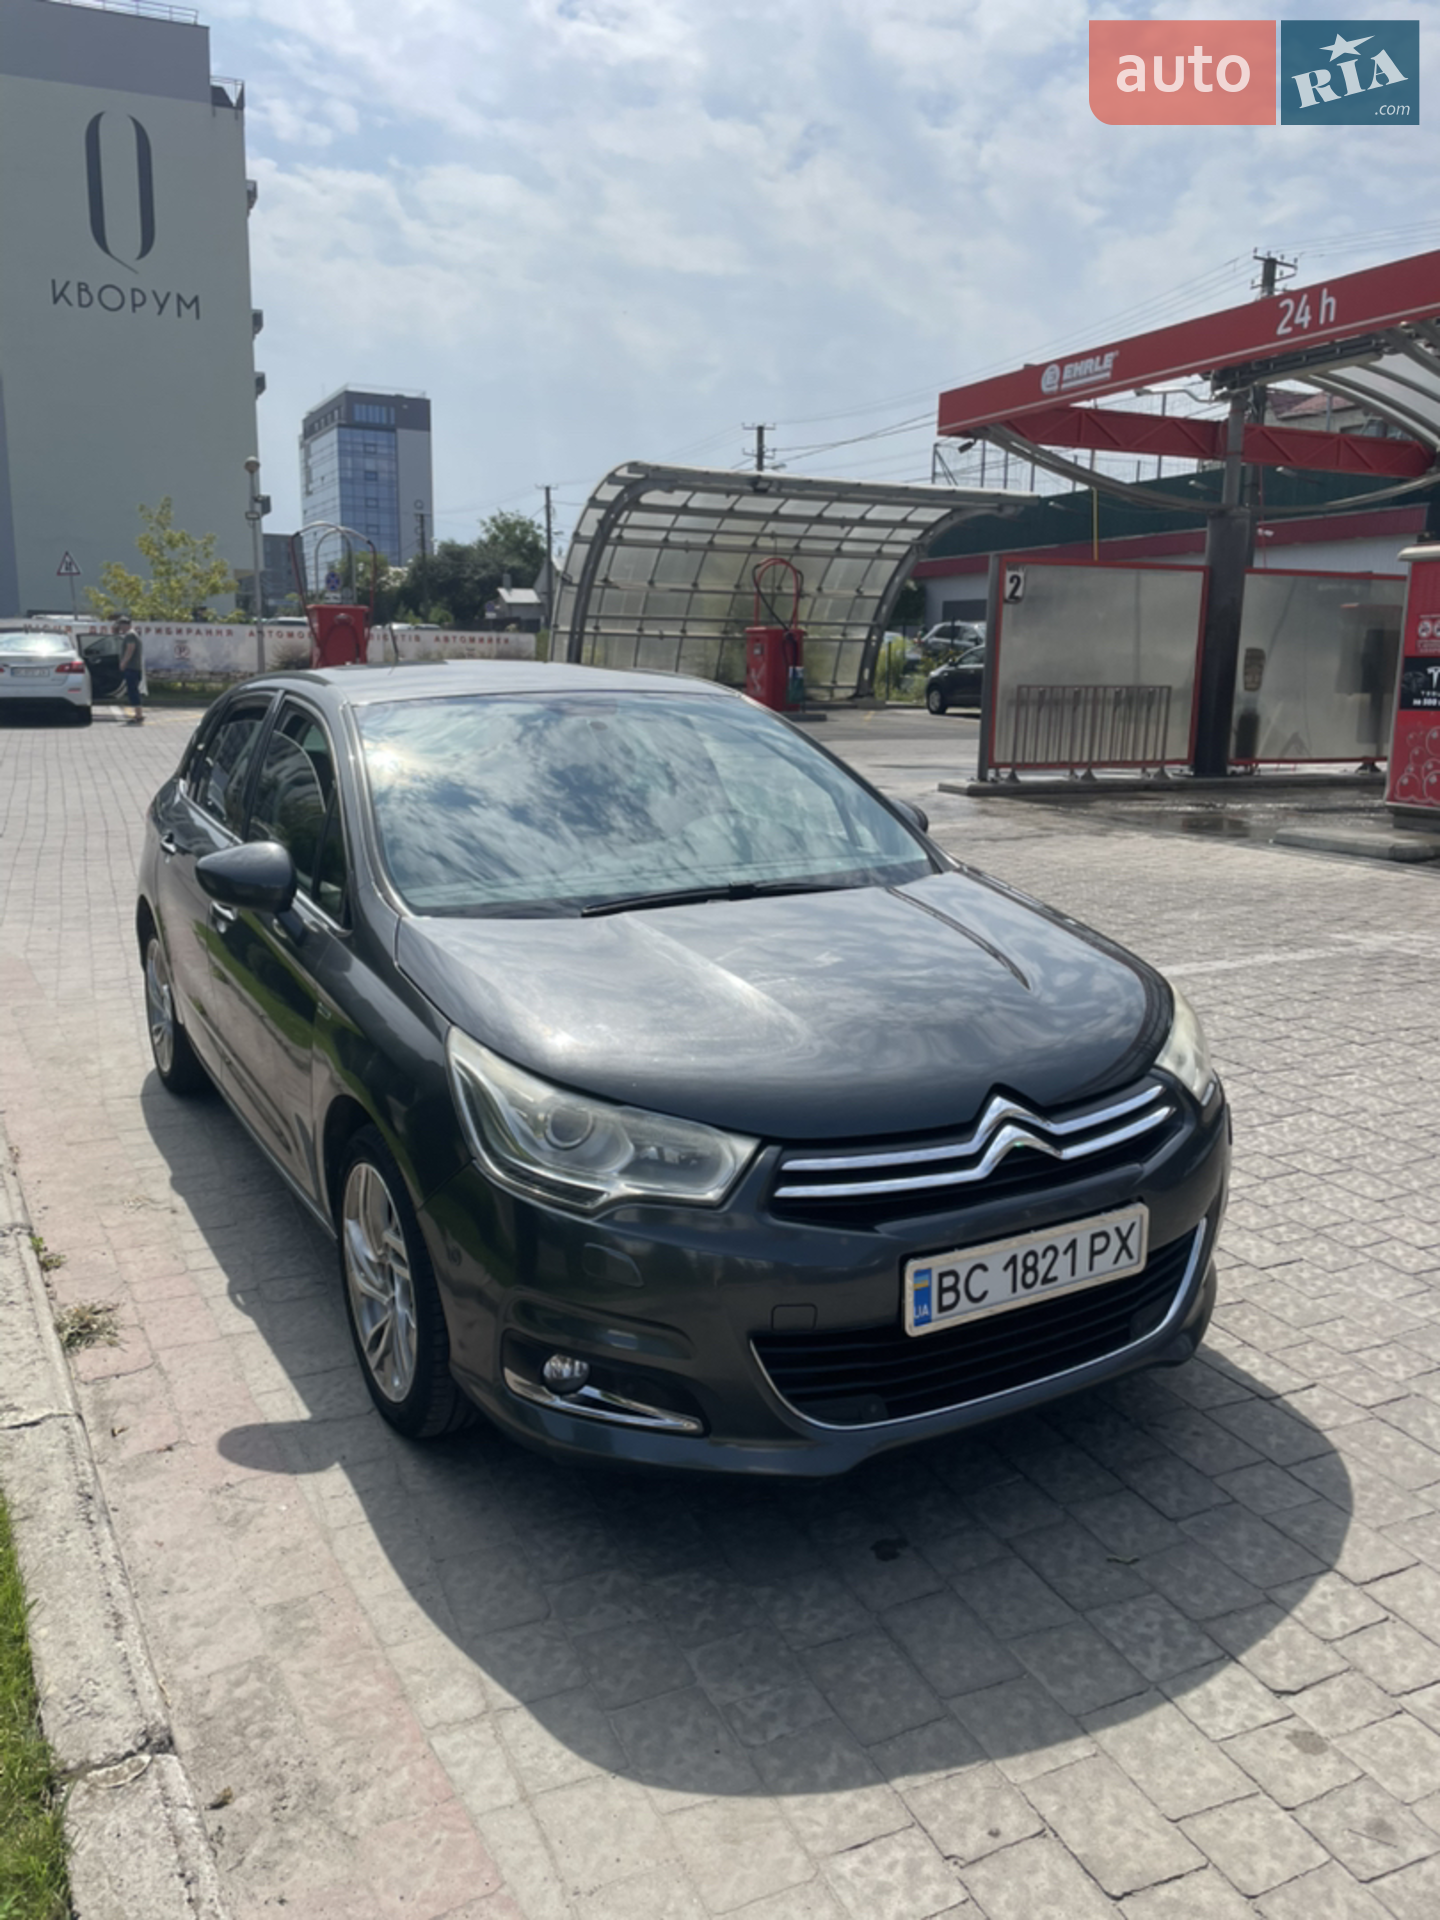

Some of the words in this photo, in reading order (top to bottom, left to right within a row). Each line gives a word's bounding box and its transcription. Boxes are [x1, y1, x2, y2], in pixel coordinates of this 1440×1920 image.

[51, 278, 201, 321] КВОРУМ
[1276, 294, 1312, 335] 24
[1319, 288, 1336, 325] h
[1062, 351, 1115, 381] EHRLE
[1008, 574, 1022, 600] 2
[1003, 1238, 1077, 1293] 1821
